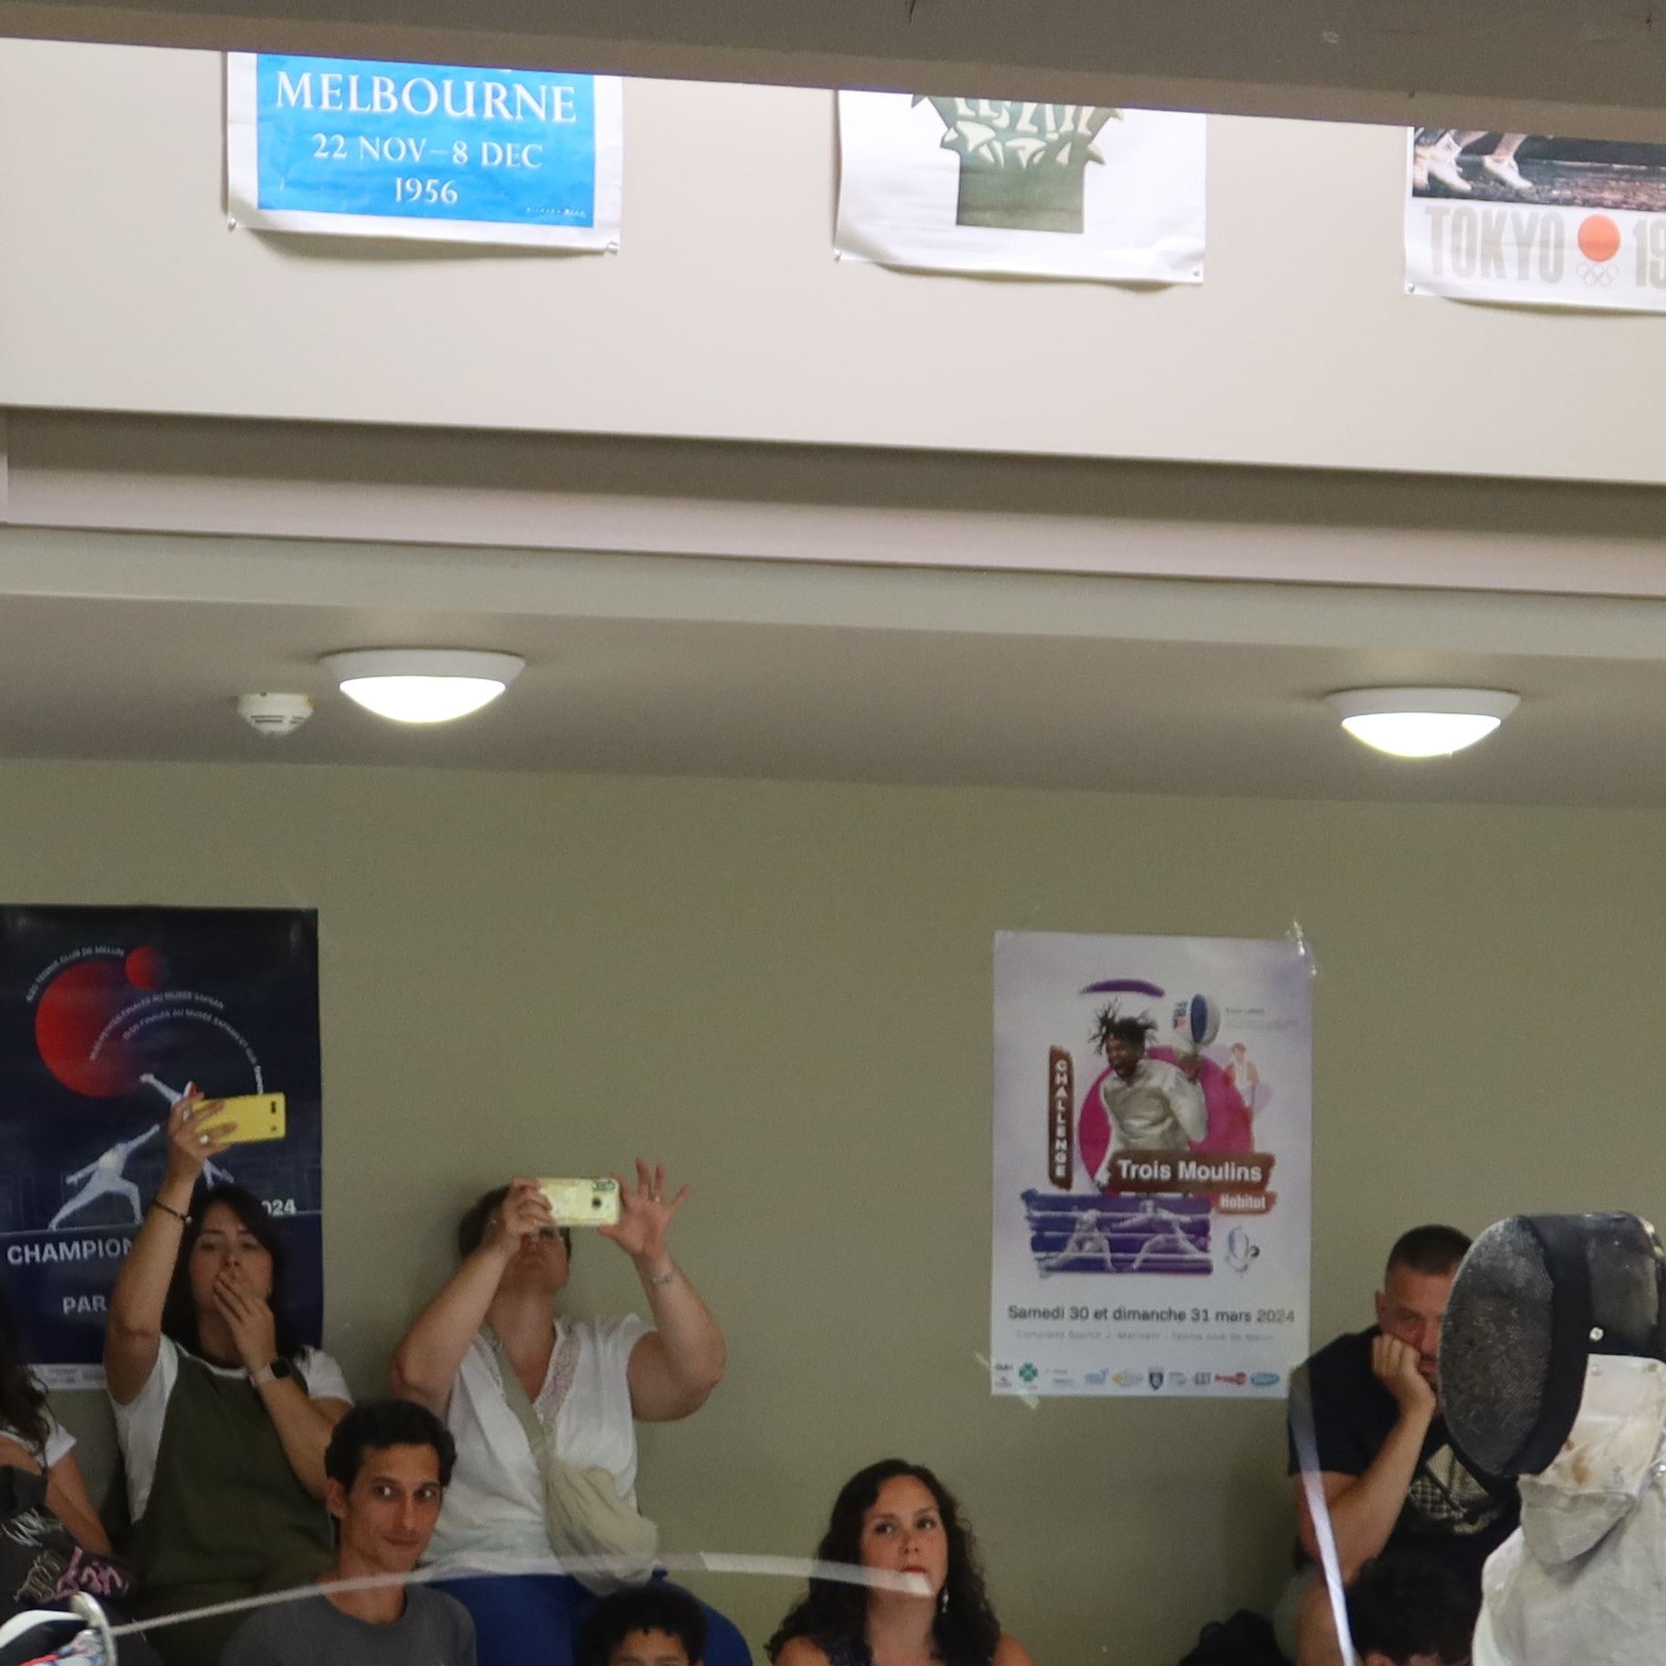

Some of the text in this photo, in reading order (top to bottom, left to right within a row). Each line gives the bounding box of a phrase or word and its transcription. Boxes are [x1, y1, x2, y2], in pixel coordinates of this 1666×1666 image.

[276, 70, 578, 123] MELBOURNE
[311, 131, 348, 160] 22
[359, 135, 429, 163] NOV
[452, 141, 470, 166] 8
[480, 142, 545, 168] DEC
[394, 176, 459, 205] 1956
[1424, 205, 1565, 284] TOKYO
[1054, 1059, 1067, 1178] CHALLENGE
[1117, 1158, 1263, 1182] Trois Moulins
[1007, 1304, 1295, 1324] Samedi 30 et dimanche 31 mars 2024
